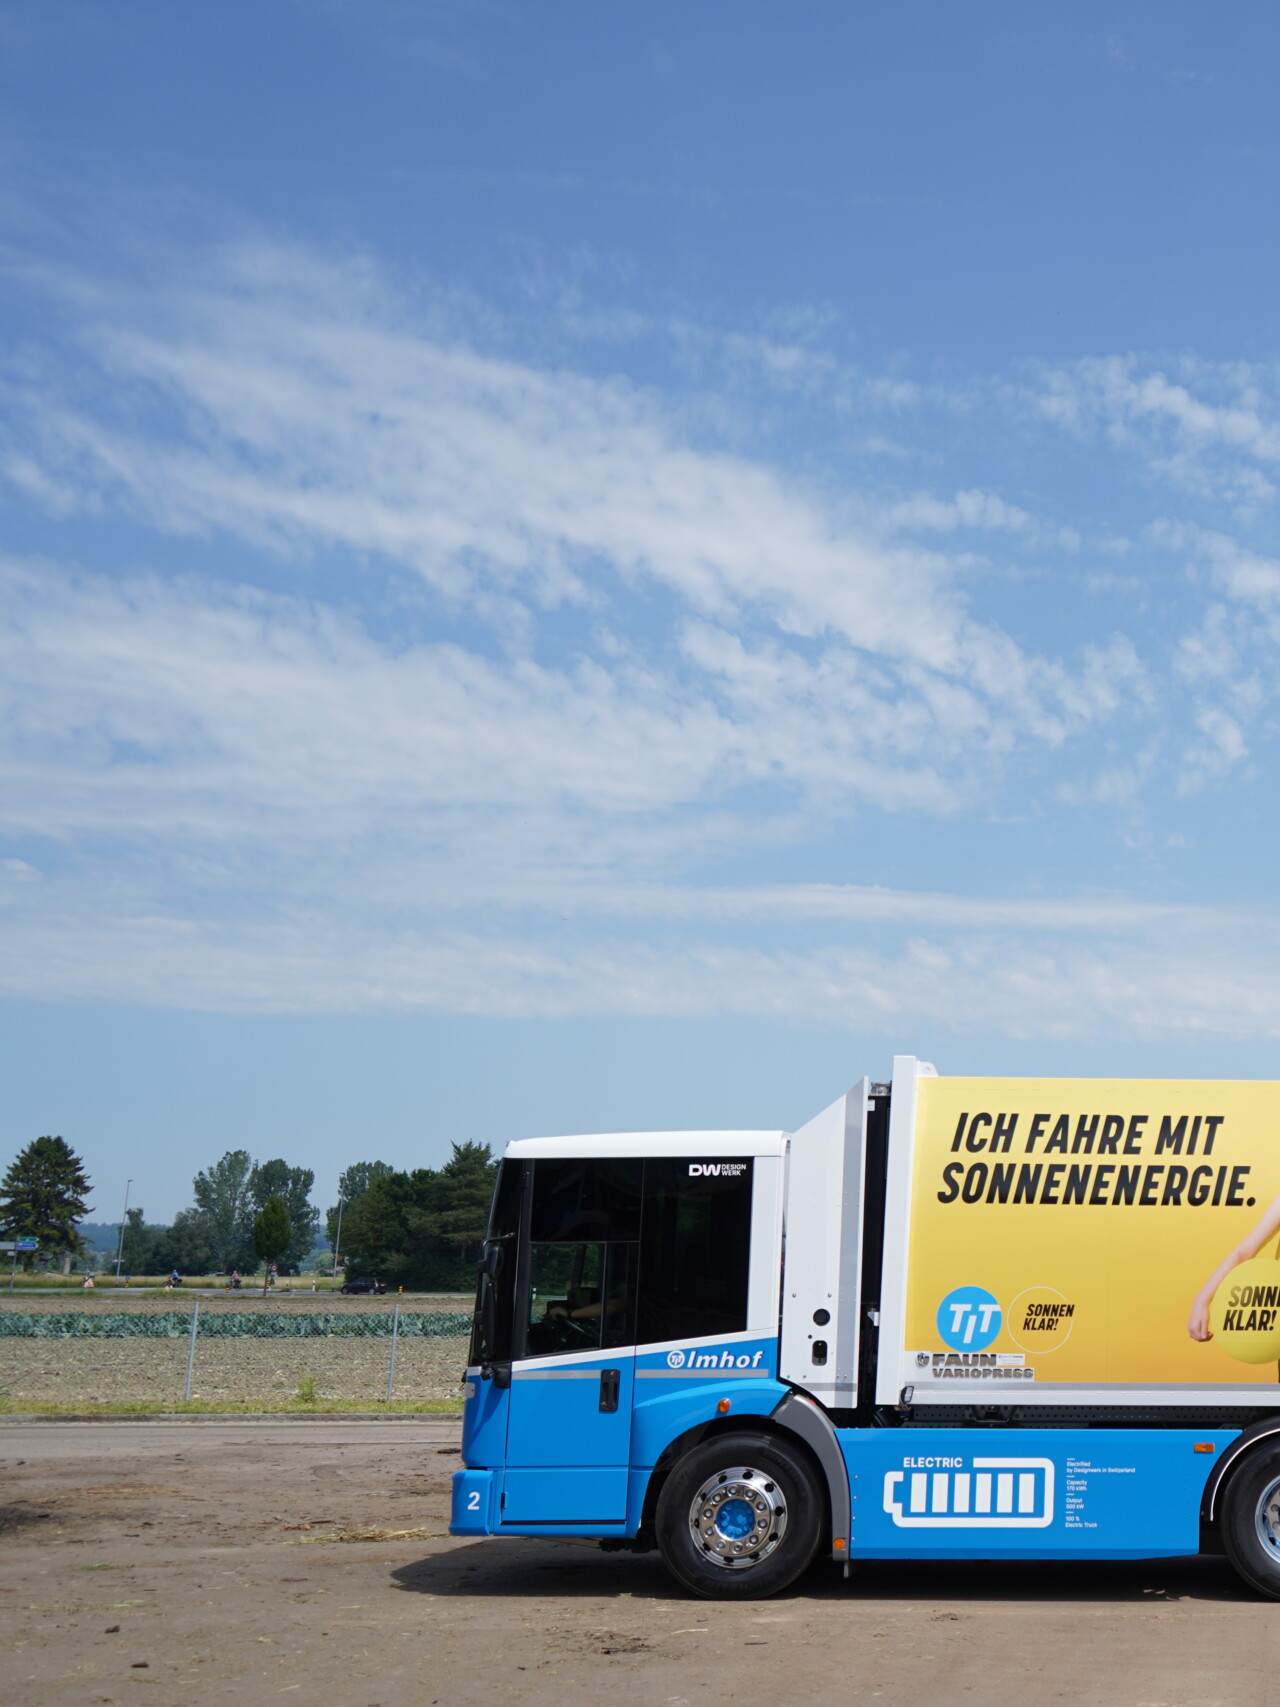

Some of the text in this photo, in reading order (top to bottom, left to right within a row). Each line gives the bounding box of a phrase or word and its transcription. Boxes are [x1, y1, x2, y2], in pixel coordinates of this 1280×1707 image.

[951, 1112, 1225, 1156] ICH FAHRE MIT
[689, 1164, 721, 1177] DW
[937, 1162, 1257, 1208] SONNENENERGIE.
[1026, 1304, 1075, 1317] SONNEN
[949, 1303, 1002, 1344] TIT
[1022, 1318, 1059, 1331] KLAR!
[1223, 1309, 1278, 1331] KLAR!
[687, 1351, 764, 1368] Imhof
[932, 1353, 997, 1367] FAUN
[932, 1368, 1034, 1379] VARIOPRESS
[903, 1457, 963, 1468] ELECTRIC
[467, 1491, 480, 1510] 2
